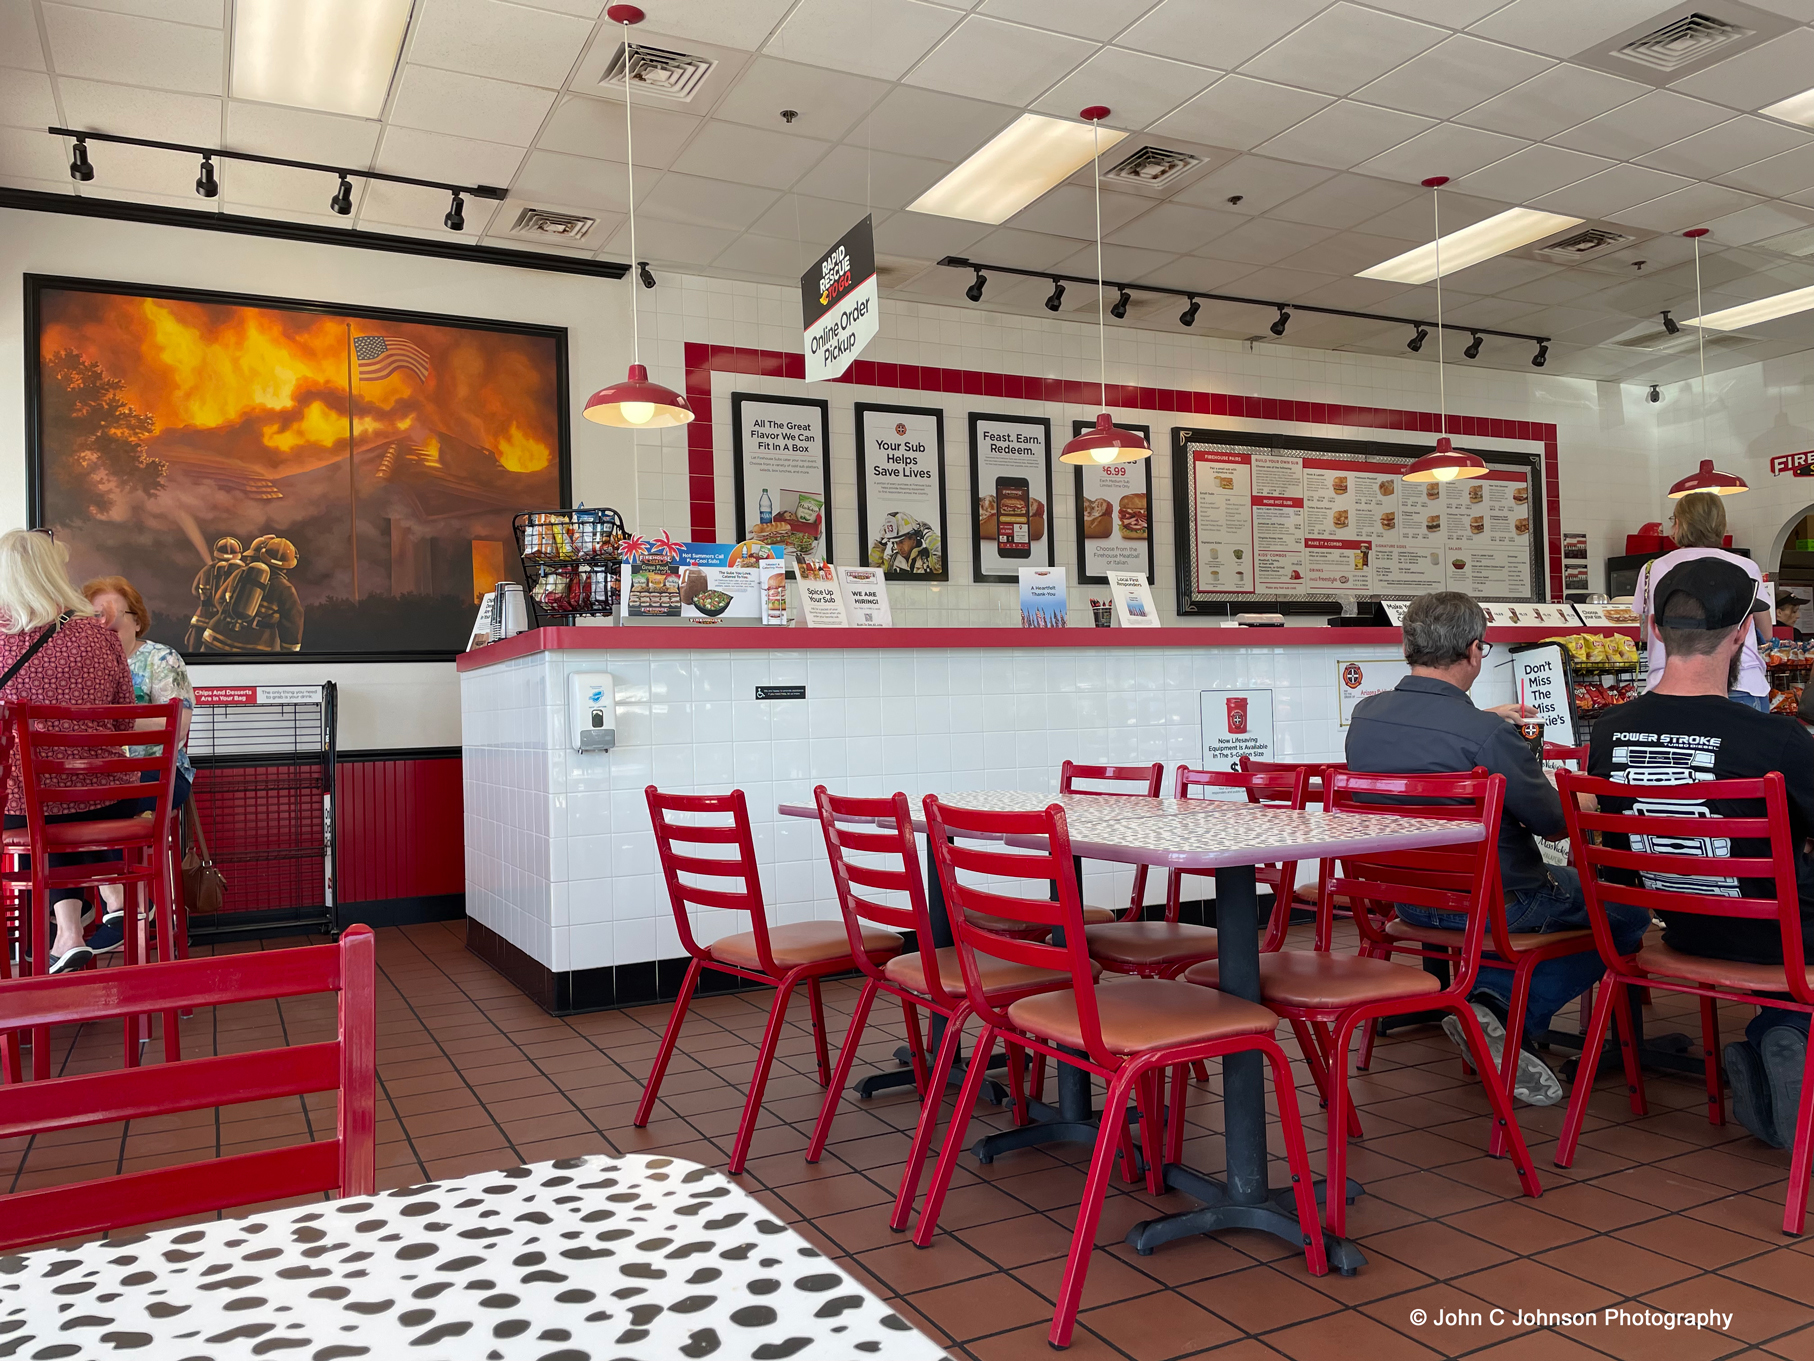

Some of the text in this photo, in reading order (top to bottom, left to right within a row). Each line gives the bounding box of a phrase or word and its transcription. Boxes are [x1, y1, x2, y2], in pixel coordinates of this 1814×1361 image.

[822, 245, 845, 277] RAPID
[819, 255, 851, 293] RESCUE
[828, 282, 839, 301] TO
[810, 296, 870, 355] Online Order
[824, 331, 856, 368] Pickup
[753, 419, 811, 432] All The Great
[750, 430, 815, 442] Flavor We Can
[983, 431, 1042, 445] Feast. Earn.
[758, 442, 809, 453] Fit In A Box
[876, 440, 926, 453] Your Sub
[990, 443, 1035, 456] Redeem.
[887, 453, 918, 467] Helps
[874, 465, 932, 478] Save Lives
[1102, 466, 1126, 476] $6.99
[806, 588, 834, 597] Spice Up
[1524, 660, 1552, 675] Don't
[1528, 676, 1552, 688] Miss
[1531, 690, 1552, 700] The
[1532, 703, 1556, 714] Miss
[1612, 732, 1722, 747] POWER STROKE
